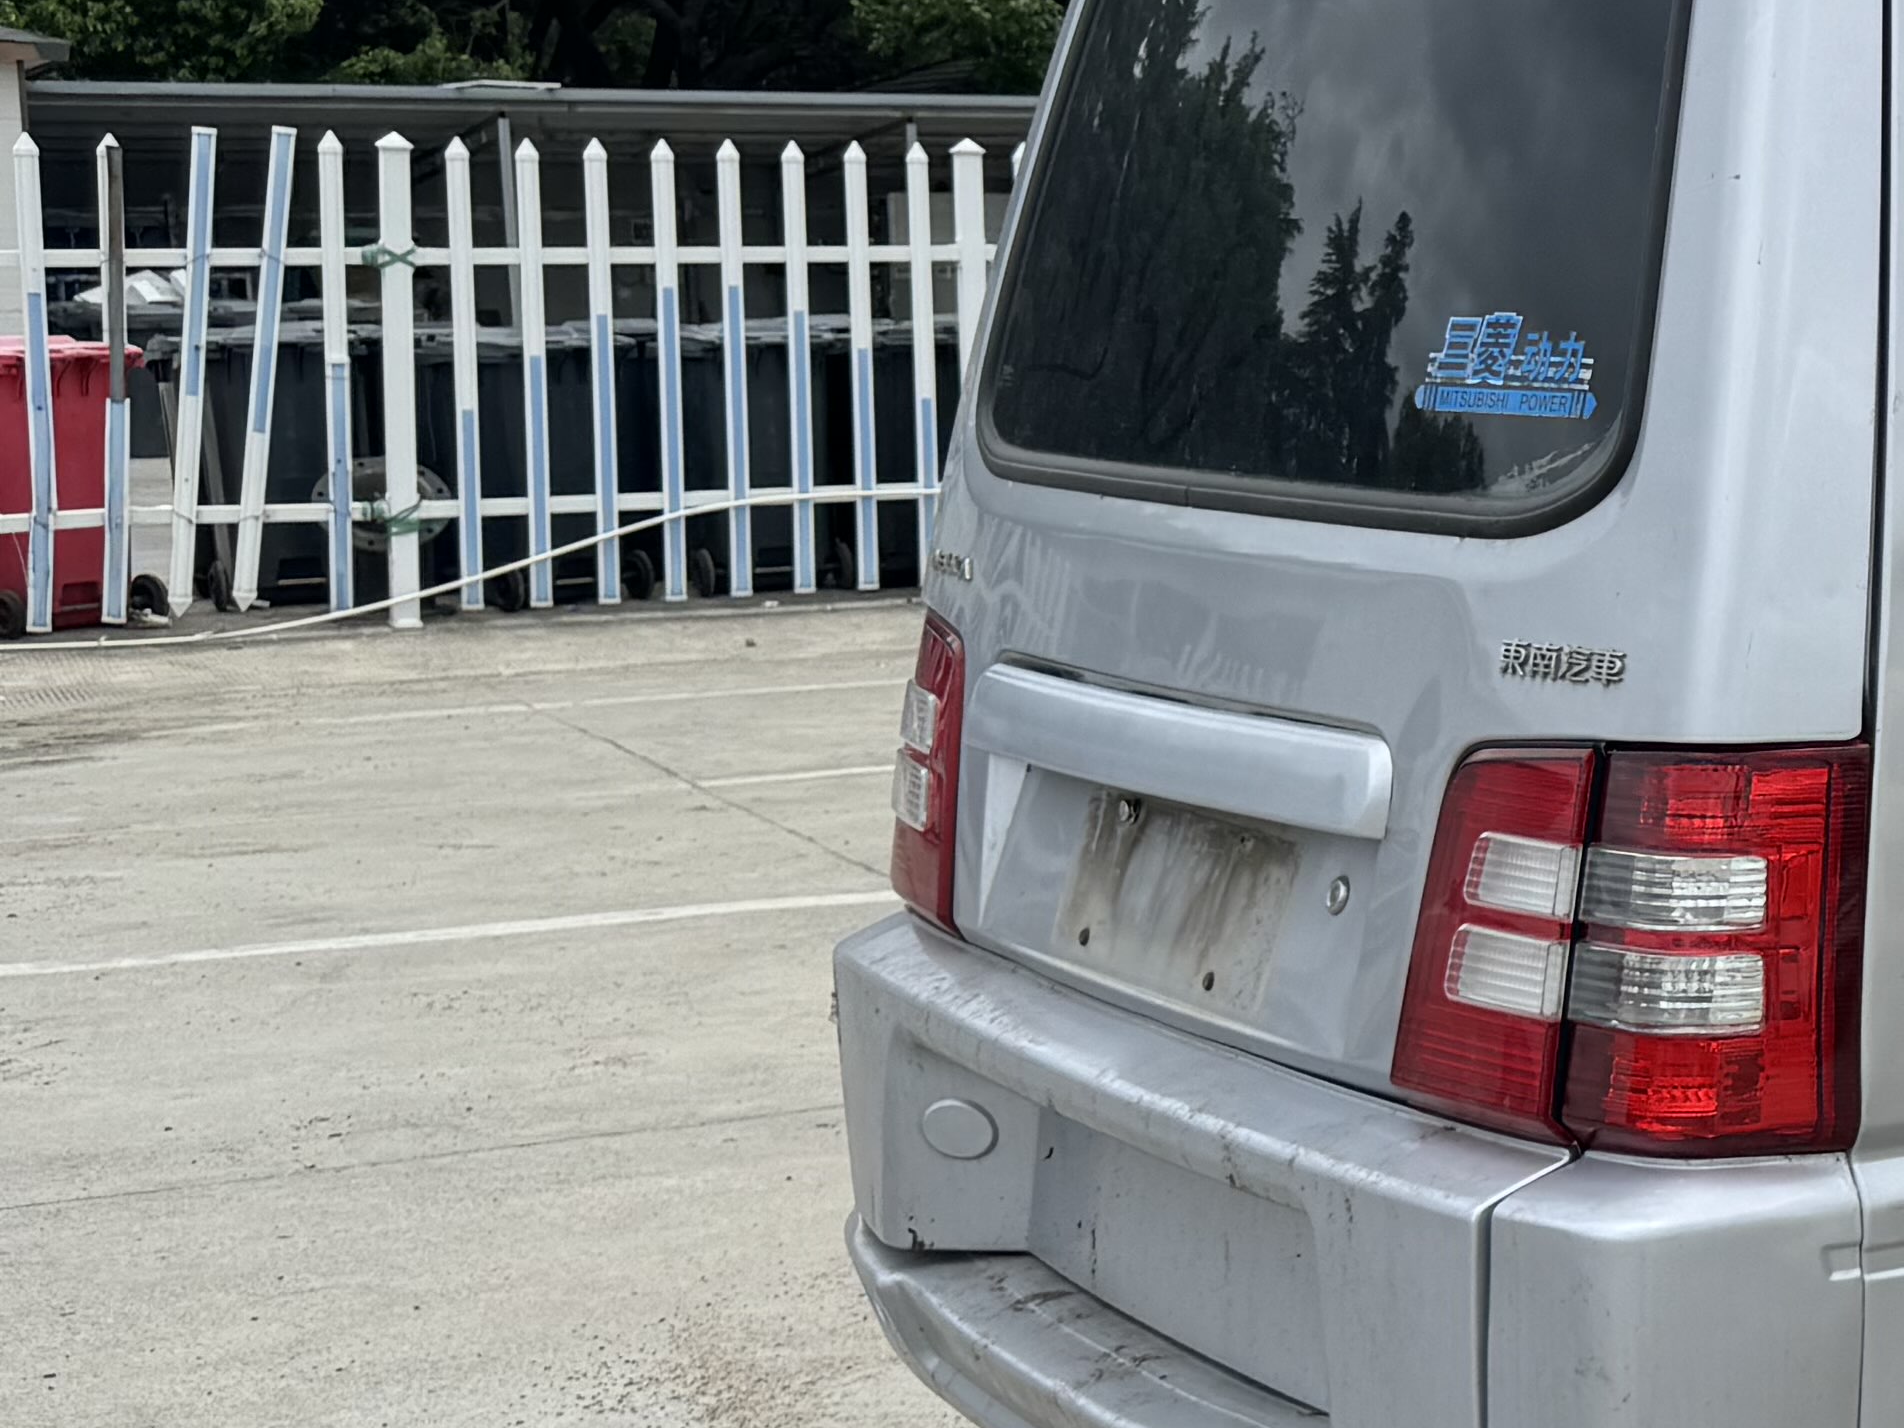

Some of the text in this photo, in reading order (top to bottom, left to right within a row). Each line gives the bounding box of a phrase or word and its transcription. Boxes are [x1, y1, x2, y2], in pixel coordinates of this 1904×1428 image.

[1431, 312, 1586, 385] 三菱动力
[1440, 390, 1569, 413] MITSUBISHI POWER
